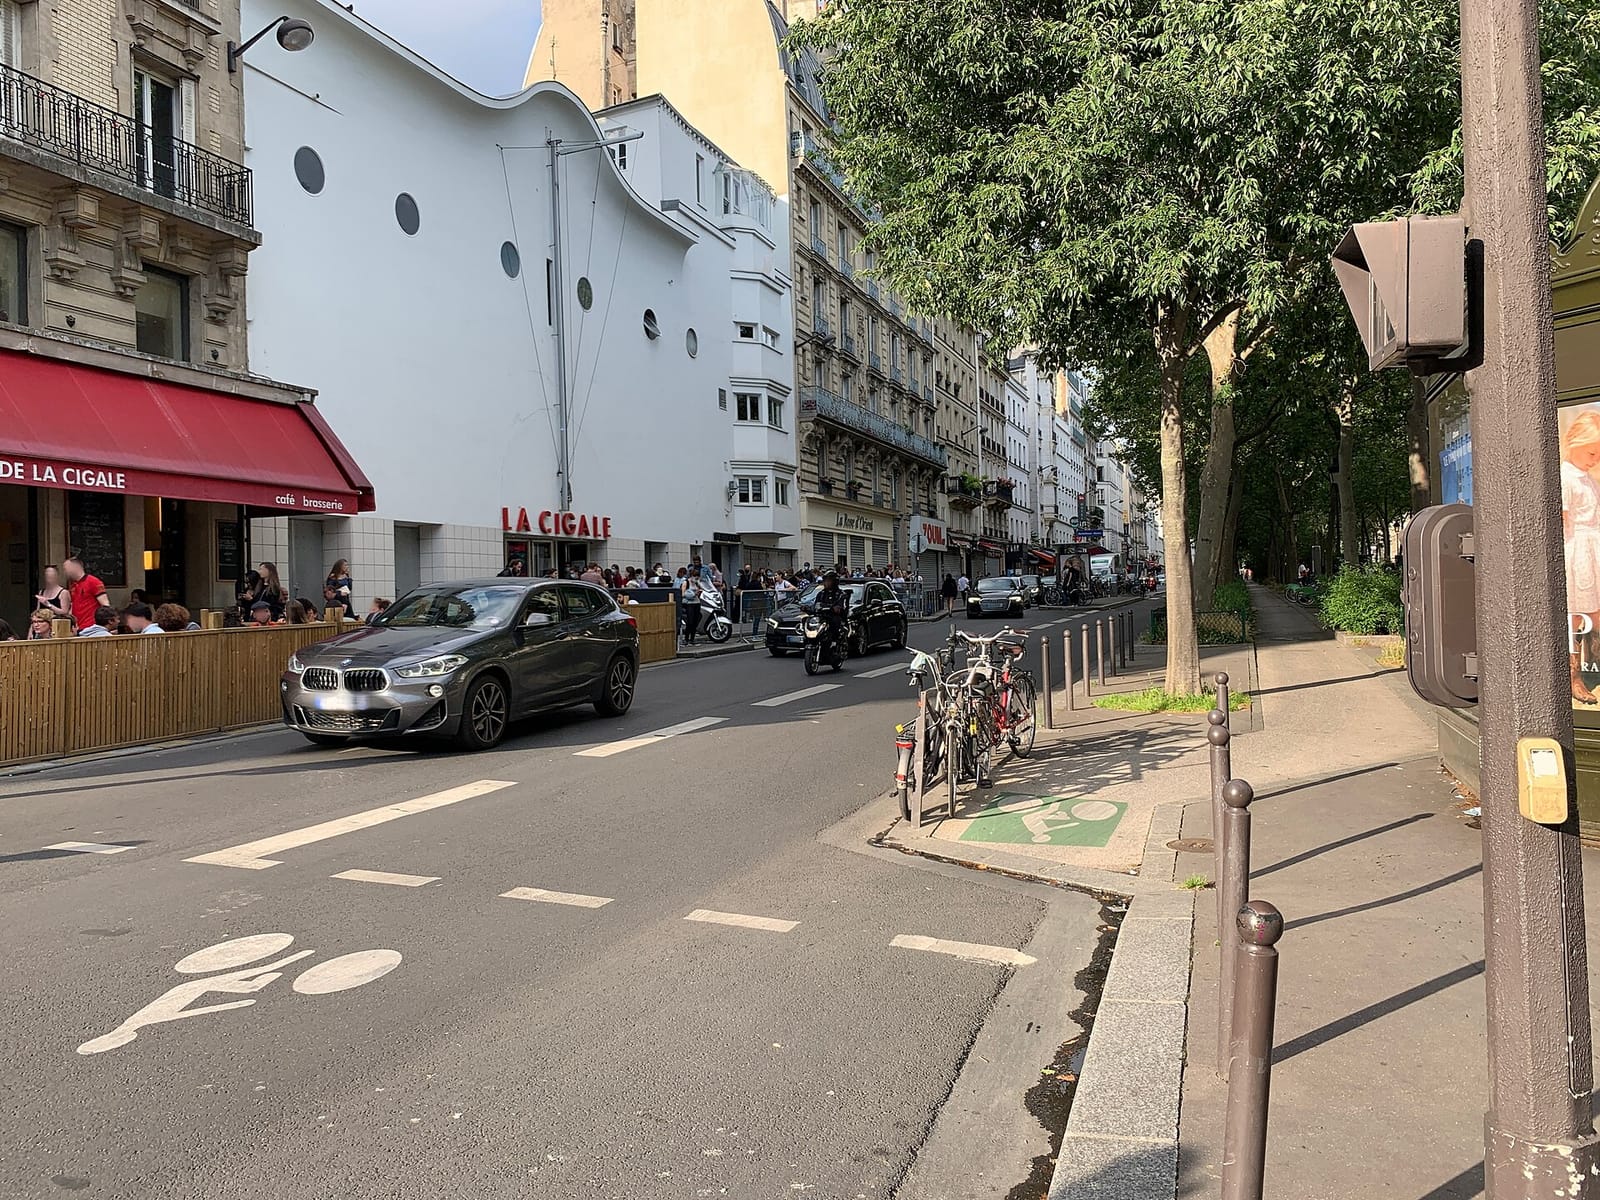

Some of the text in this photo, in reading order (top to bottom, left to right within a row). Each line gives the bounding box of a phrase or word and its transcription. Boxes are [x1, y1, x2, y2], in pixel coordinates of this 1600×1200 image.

[0, 460, 126, 489] DE LA CIGALE
[275, 493, 343, 510] café brasserie
[502, 507, 612, 539] LA CIGALE
